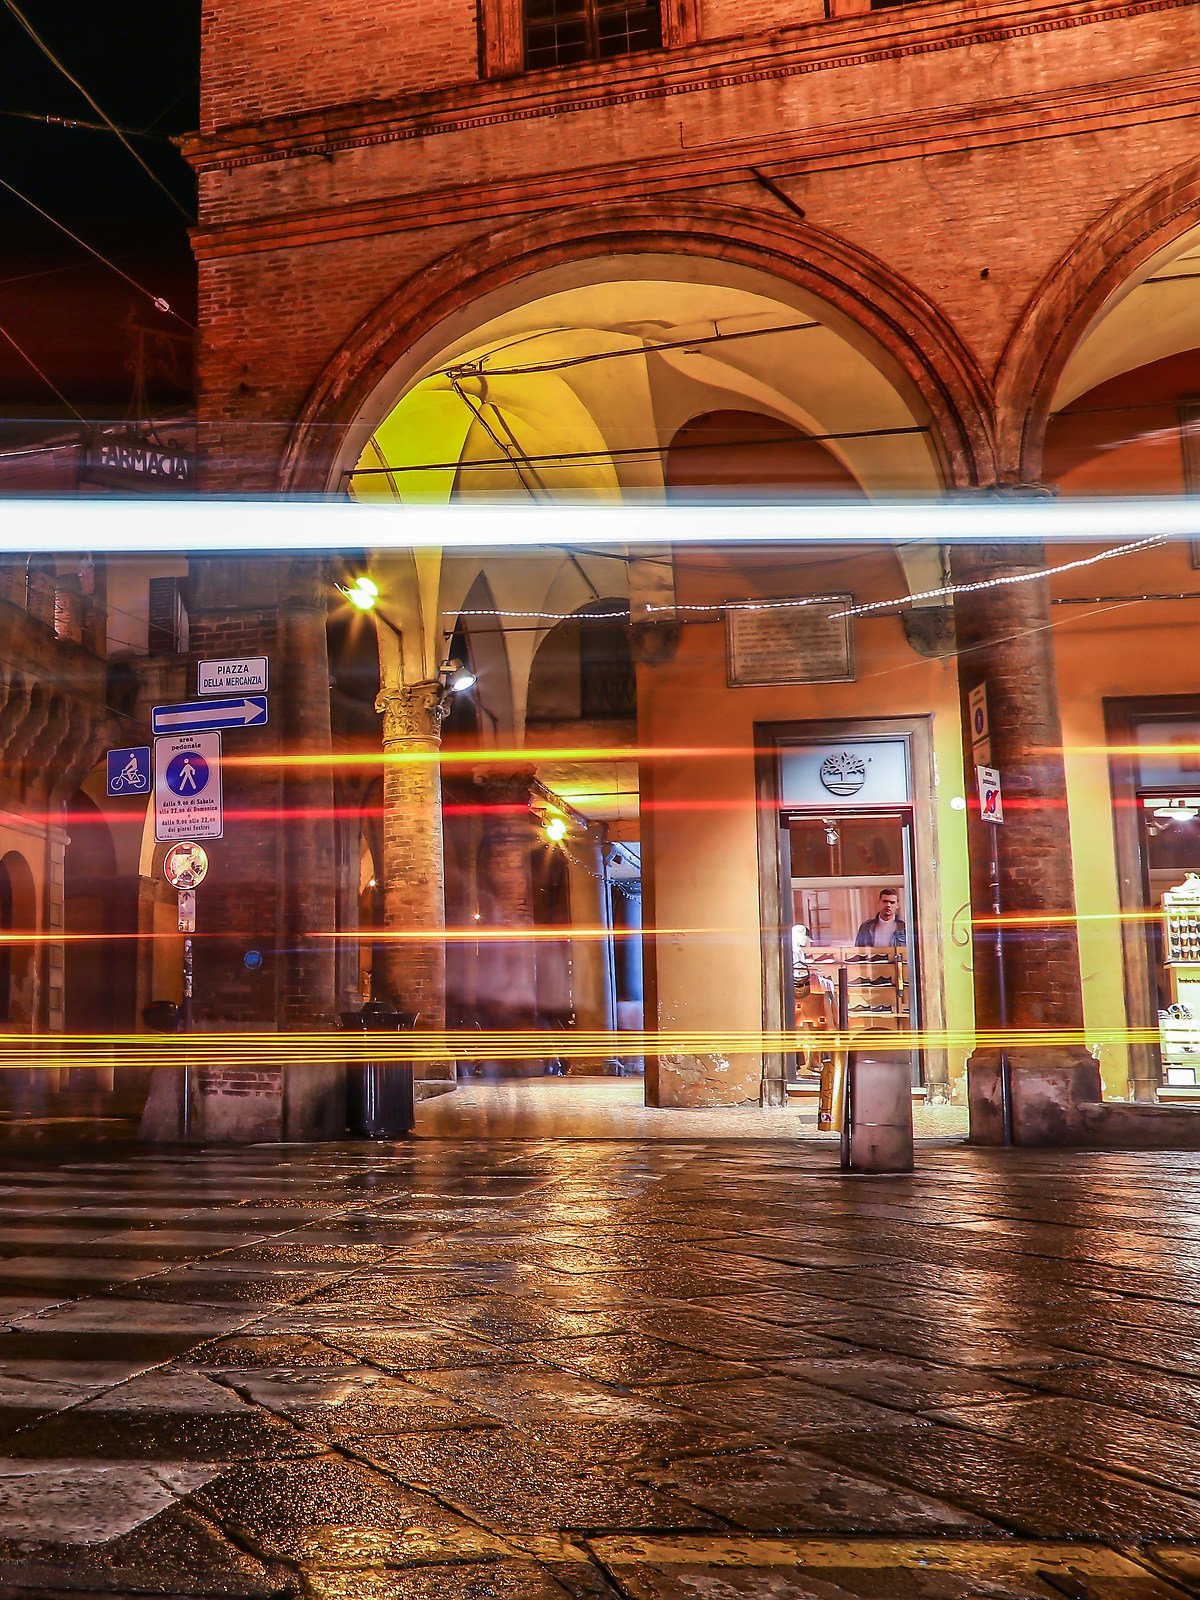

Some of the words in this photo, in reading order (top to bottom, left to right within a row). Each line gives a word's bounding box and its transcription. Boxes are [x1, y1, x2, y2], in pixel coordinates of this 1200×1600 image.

[99, 445, 190, 481] FARMACIA
[217, 664, 249, 675] PIAZZA
[203, 678, 224, 688] DELLA
[225, 676, 262, 687] MERCANZIA
[171, 743, 202, 751] pedonale
